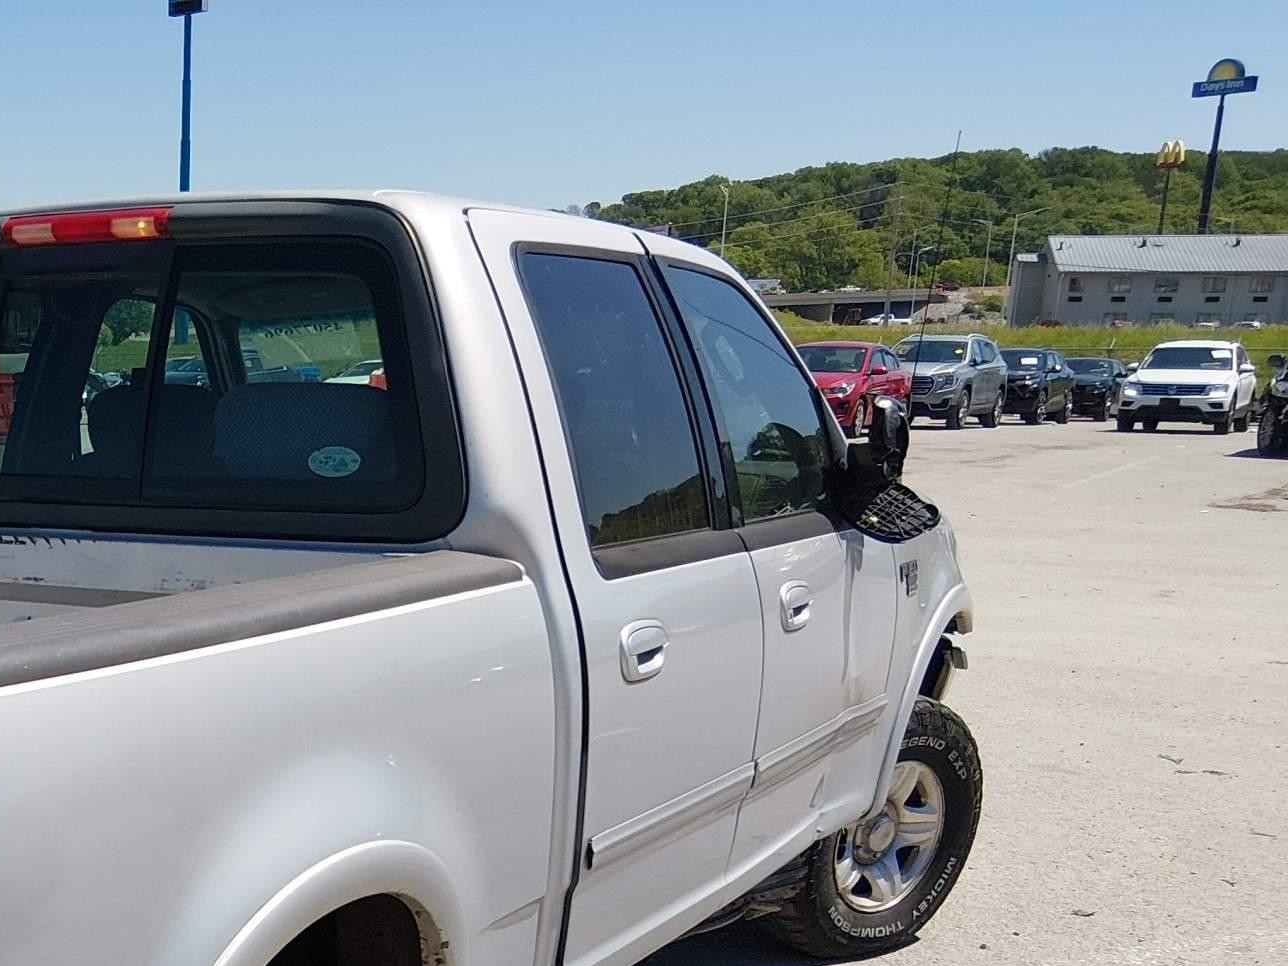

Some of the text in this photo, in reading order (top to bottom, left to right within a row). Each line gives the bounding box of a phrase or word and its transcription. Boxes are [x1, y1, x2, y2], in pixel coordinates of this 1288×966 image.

[1200, 83, 1225, 92] Days
[900, 736, 968, 779] EGEND EXP
[828, 857, 957, 938] MICKEY THOMPSON
